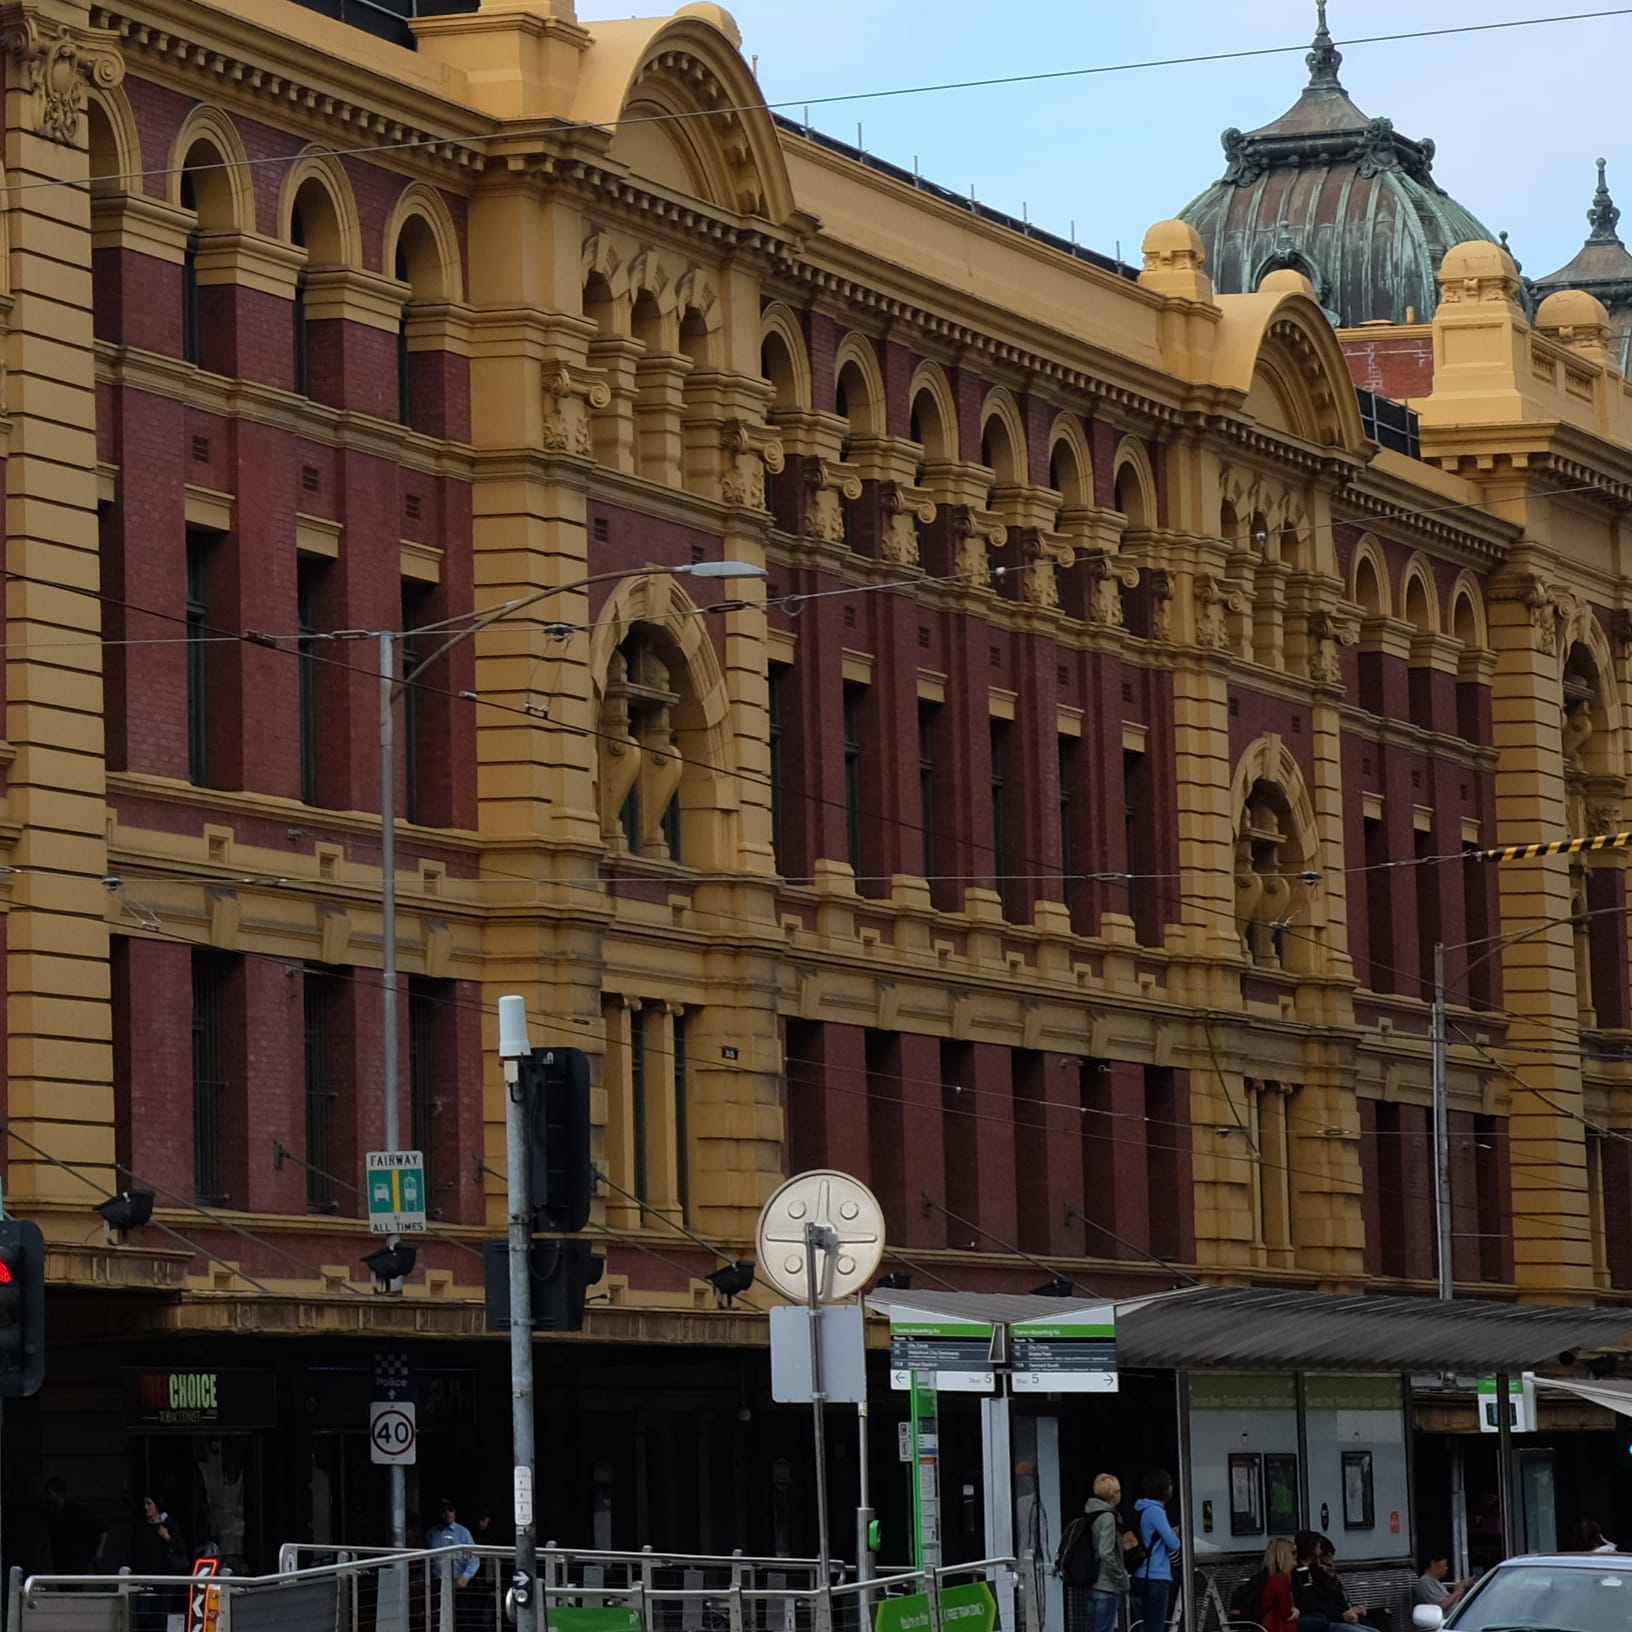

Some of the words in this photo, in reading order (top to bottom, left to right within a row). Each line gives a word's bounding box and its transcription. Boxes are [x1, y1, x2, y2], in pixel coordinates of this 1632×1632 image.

[370, 1154, 418, 1166] FAIRWAY
[373, 1223, 391, 1232] ALL
[397, 1223, 424, 1231] TIMES
[376, 1377, 408, 1387] Police
[984, 1374, 992, 1384] 5
[1032, 1374, 1040, 1384] 5
[376, 1422, 409, 1444] 40
